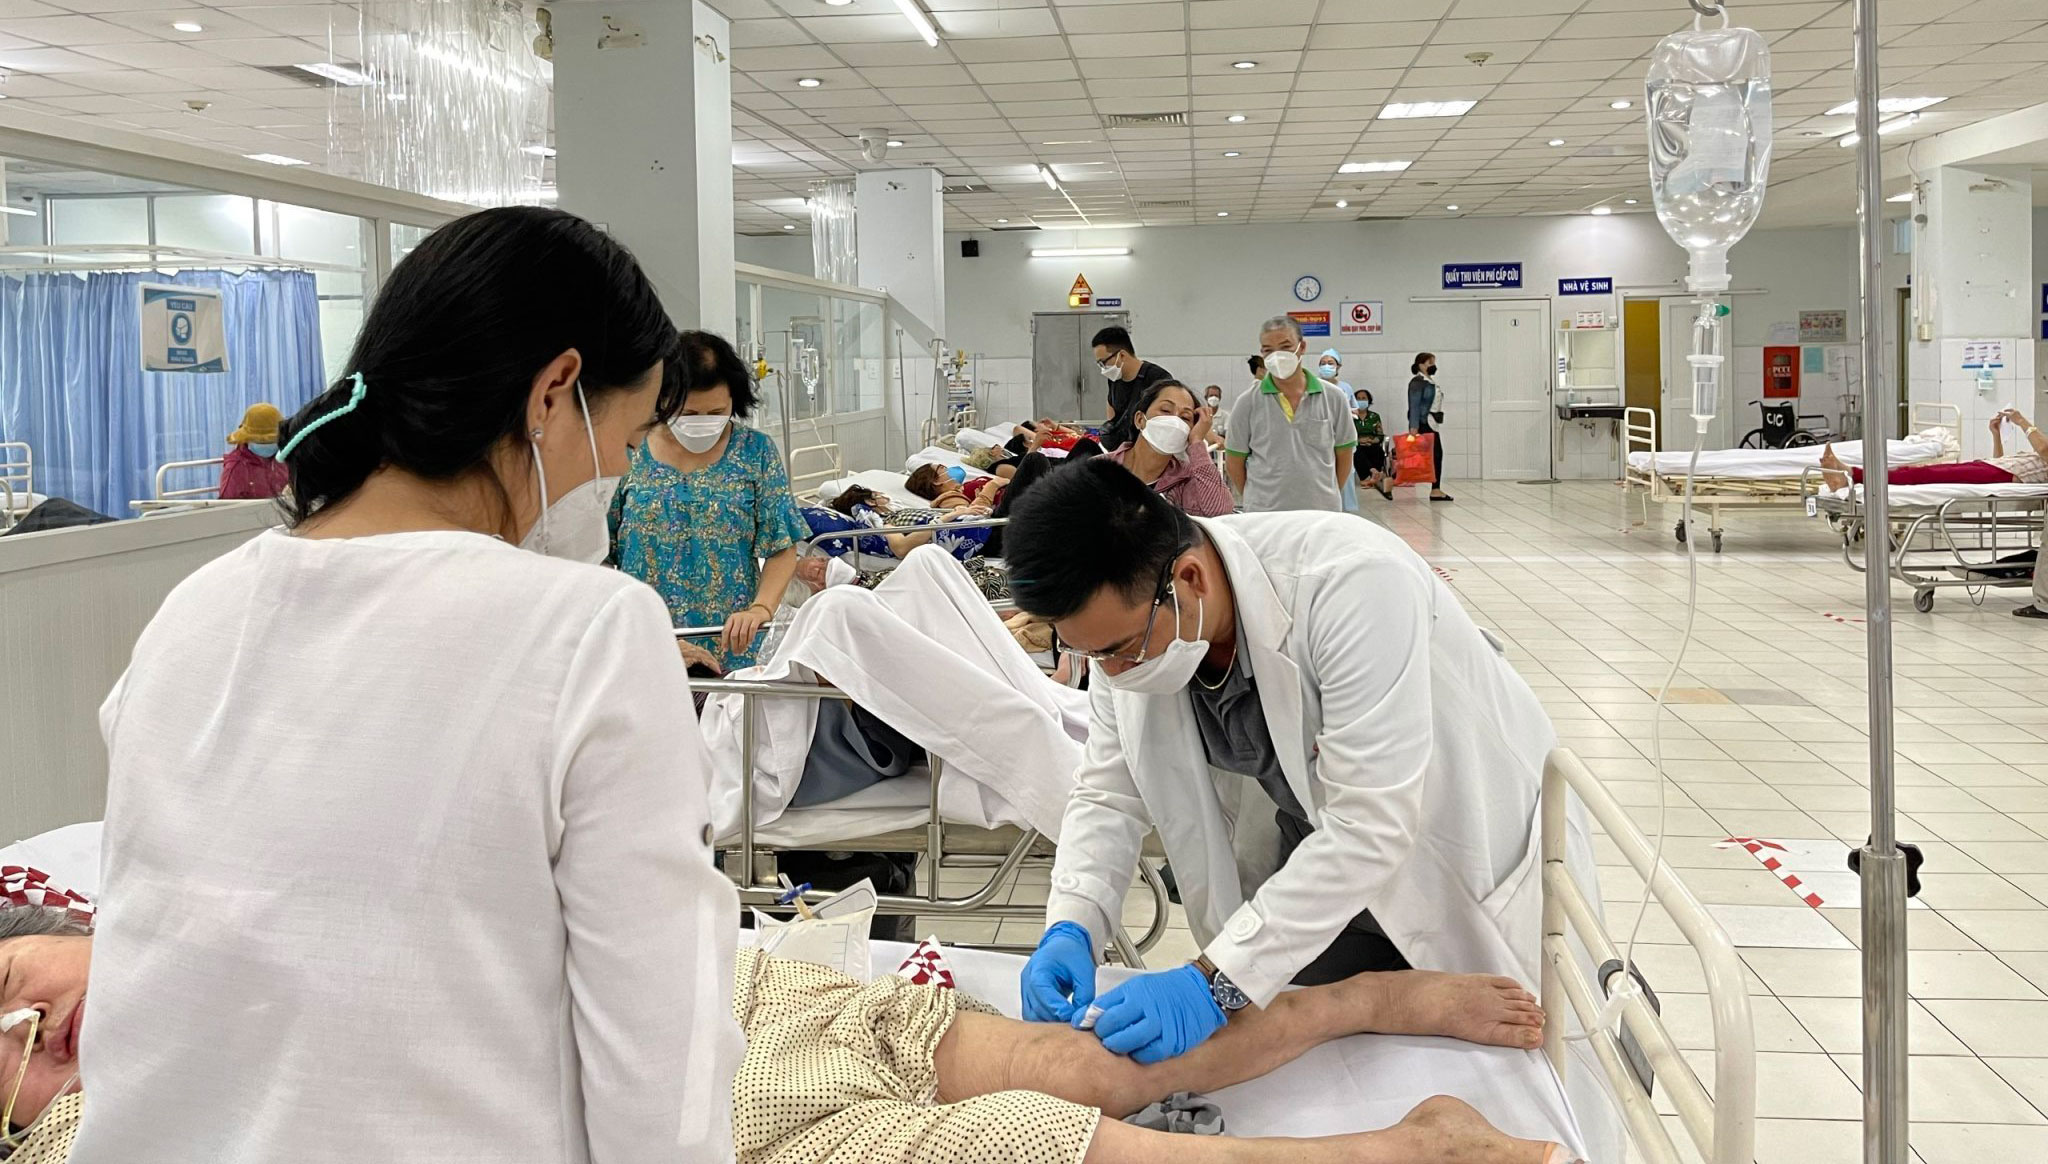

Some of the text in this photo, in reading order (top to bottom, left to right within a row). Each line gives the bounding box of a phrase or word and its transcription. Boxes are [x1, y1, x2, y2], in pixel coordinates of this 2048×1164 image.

[1461, 271, 1471, 282] THU
[1472, 269, 1485, 284] VIỆN
[1486, 268, 1495, 282] PHÍ
[1496, 266, 1507, 281] CẤP
[1563, 280, 1609, 292] NHÀ VỆ SINH
